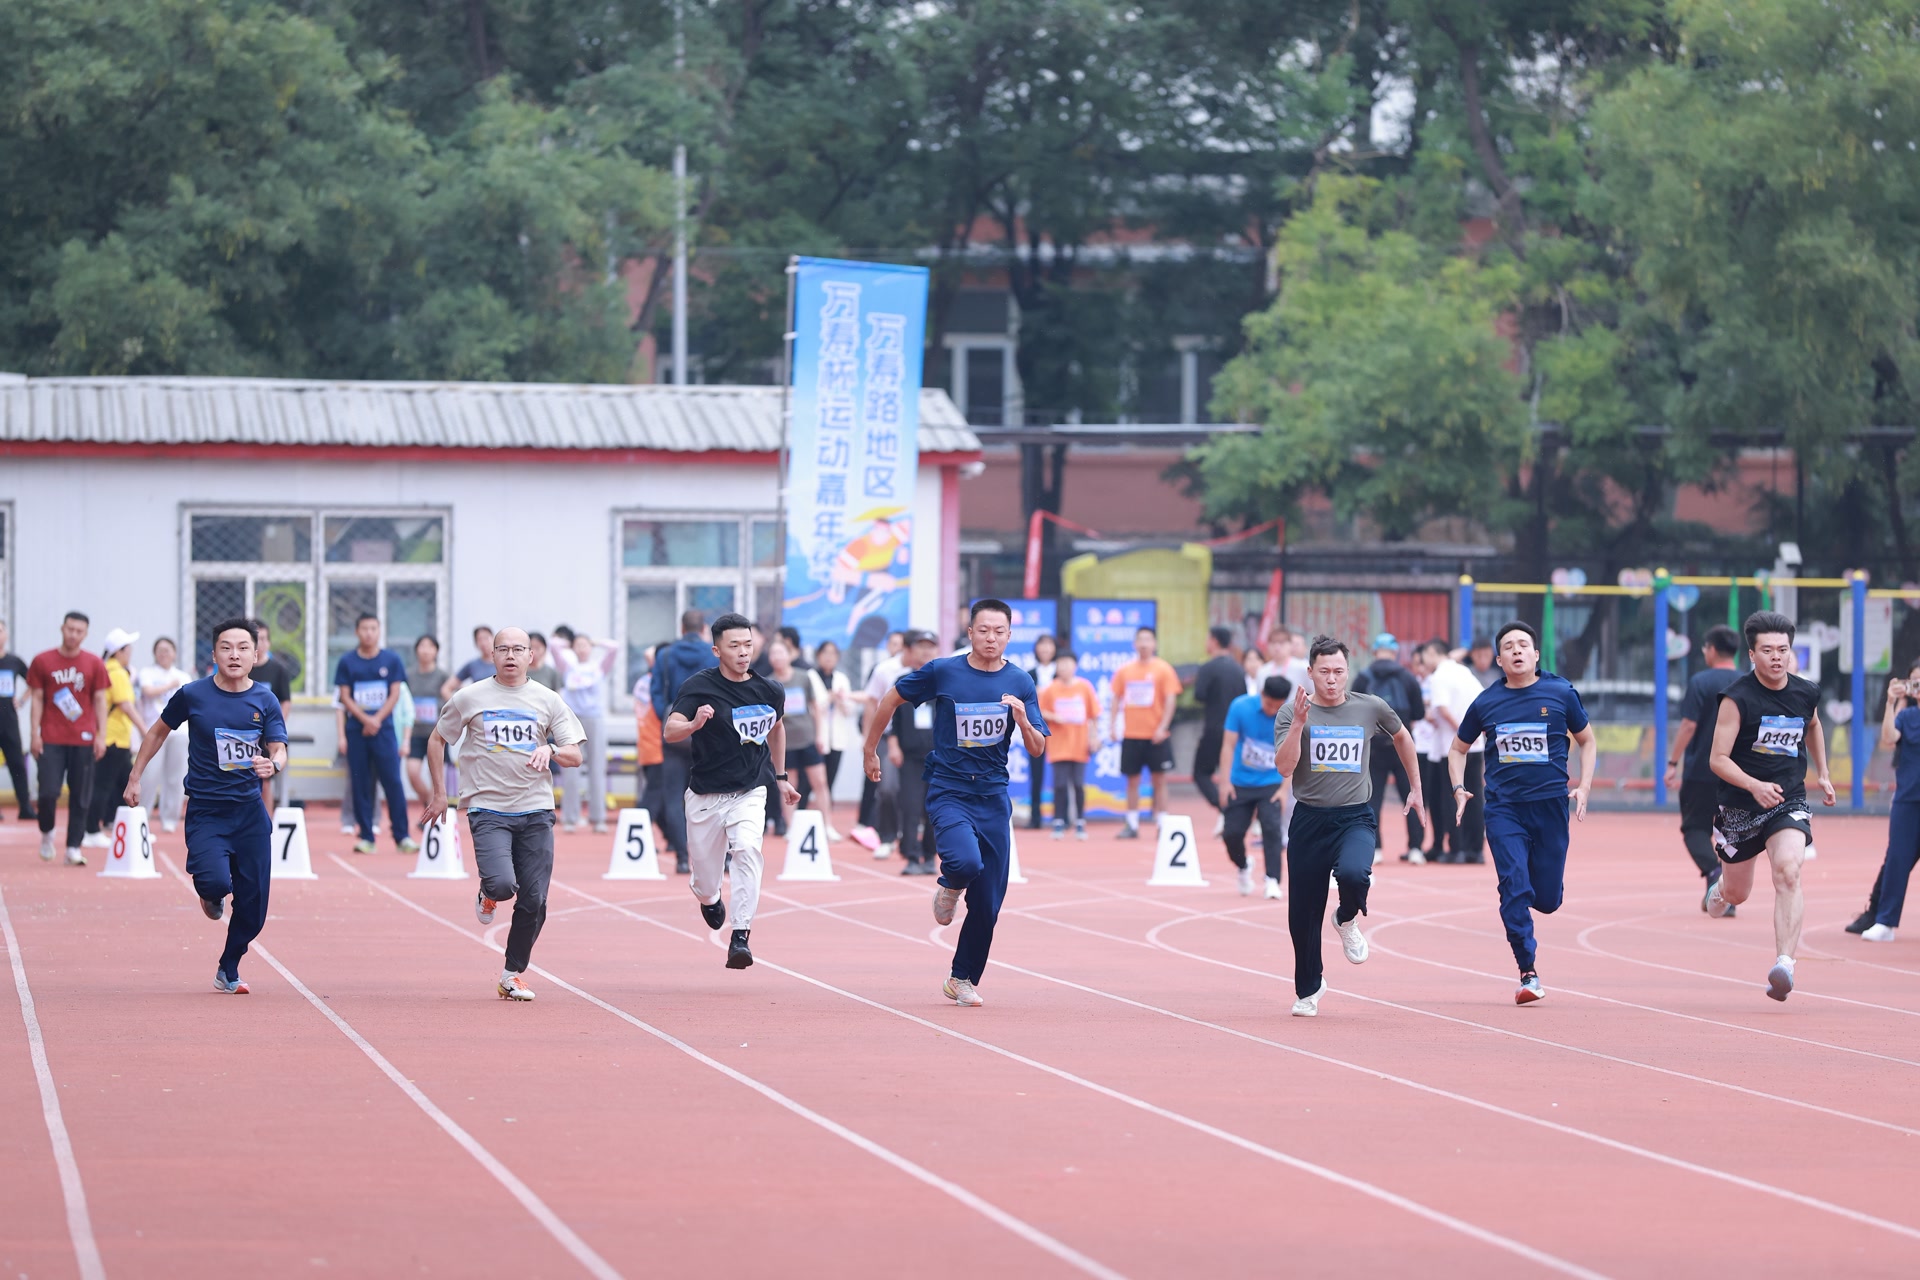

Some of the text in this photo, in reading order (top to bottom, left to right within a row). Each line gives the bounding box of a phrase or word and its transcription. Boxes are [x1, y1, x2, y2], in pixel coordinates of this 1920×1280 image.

[863, 312, 907, 499] 万寿路地区
[491, 724, 532, 742] 1101
[739, 716, 774, 737] 0501
[961, 718, 1004, 737] 1509
[1500, 736, 1544, 752] 1505
[1760, 731, 1799, 746] 0101
[1315, 742, 1359, 762] 0201
[113, 821, 127, 859] 8
[140, 821, 150, 860] 8
[278, 822, 297, 861] 7
[426, 823, 440, 860] 6
[626, 824, 645, 861] 5
[799, 825, 819, 862] 4
[1169, 831, 1188, 867] 2
